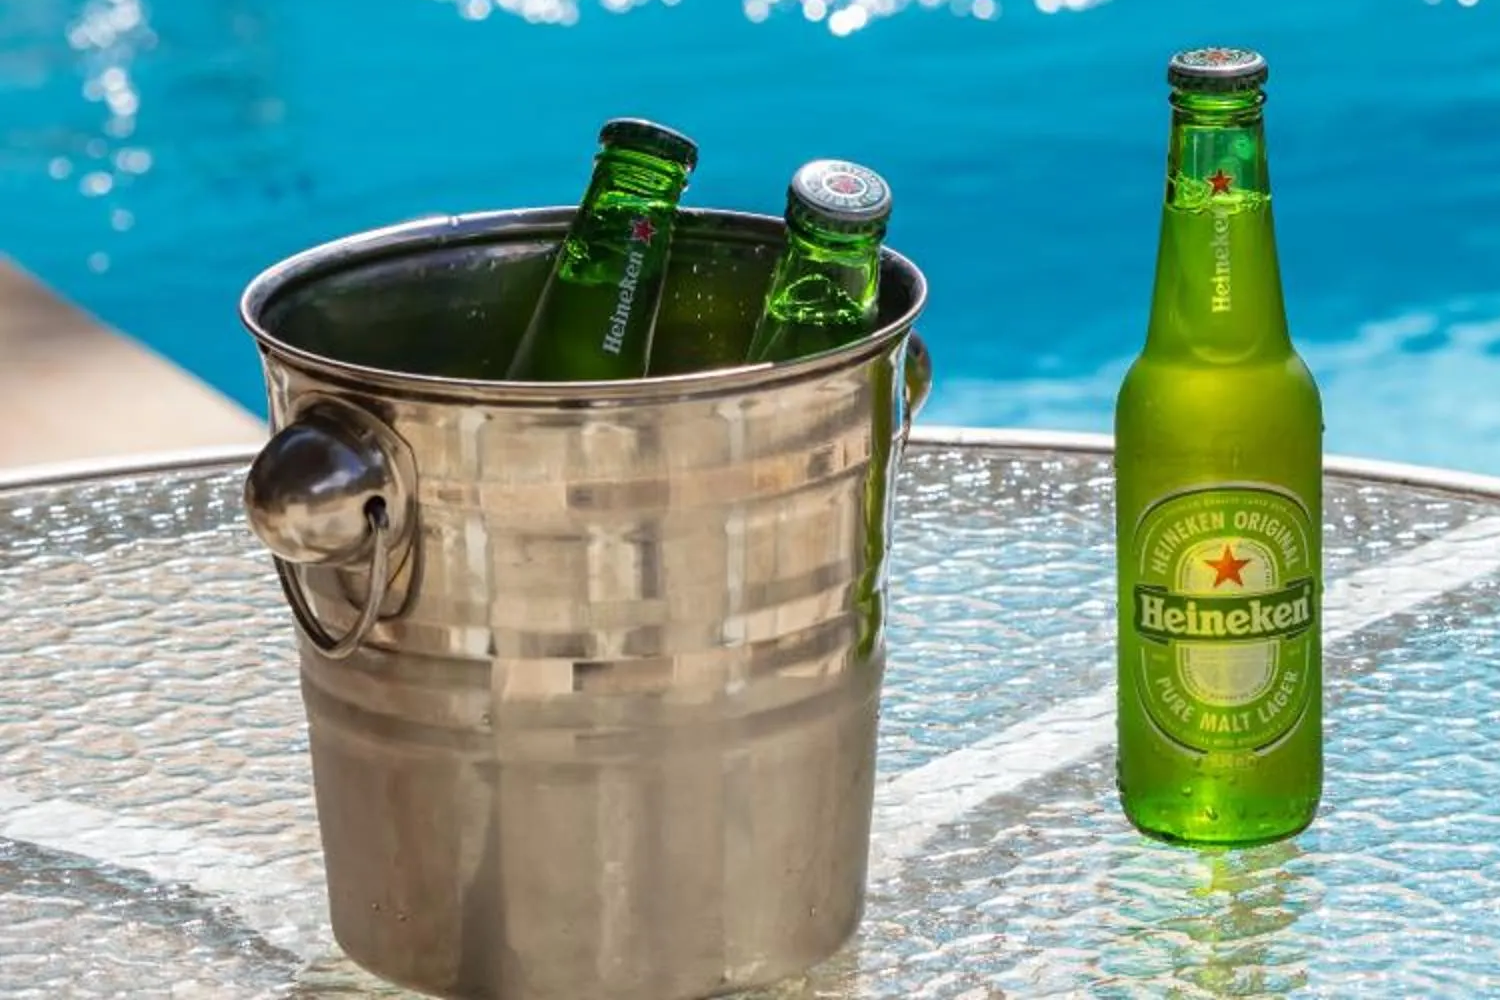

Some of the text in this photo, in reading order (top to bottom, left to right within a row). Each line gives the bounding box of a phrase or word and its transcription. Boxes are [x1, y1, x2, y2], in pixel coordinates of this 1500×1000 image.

[602, 251, 644, 354] Heineken
[1151, 510, 1225, 576] HEINEKEN
[1233, 510, 1300, 572] ORIGINAL
[1139, 594, 1310, 637] Heineken
[1155, 676, 1195, 723] PURE
[1199, 711, 1251, 733] MALT
[1257, 668, 1299, 723] LAGER
